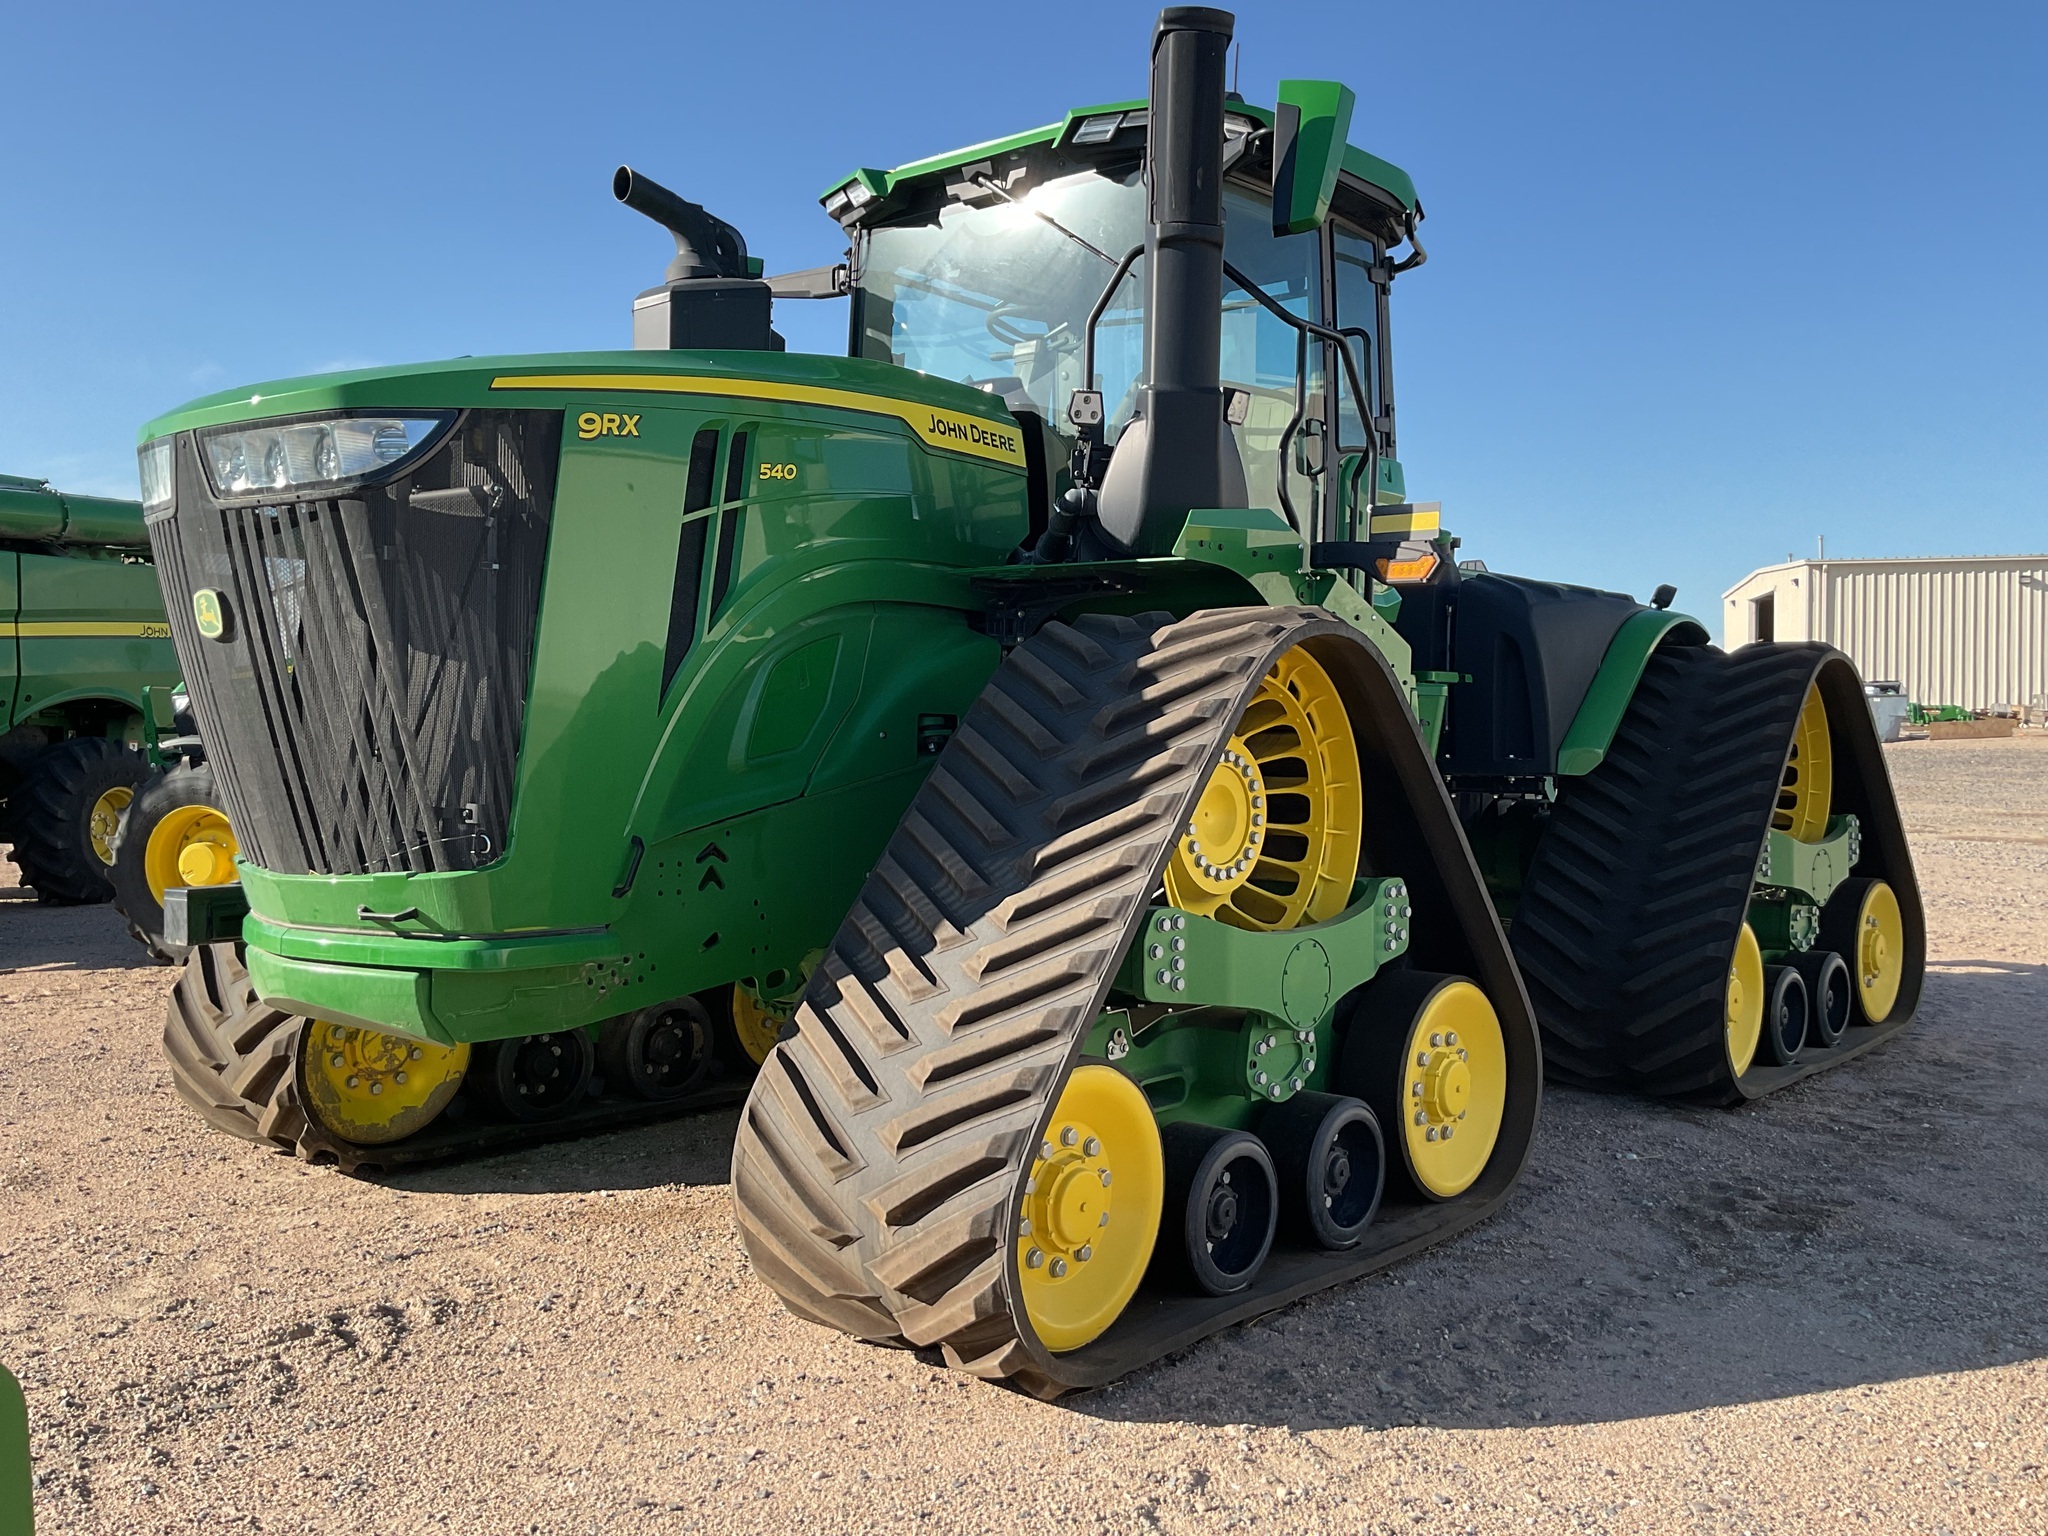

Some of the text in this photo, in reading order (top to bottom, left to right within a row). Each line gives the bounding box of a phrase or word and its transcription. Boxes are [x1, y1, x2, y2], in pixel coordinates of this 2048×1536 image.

[577, 411, 642, 440] 9RX
[928, 413, 1016, 453] JOHN DEERE
[759, 463, 798, 480] 540
[140, 624, 168, 636] JOHN
